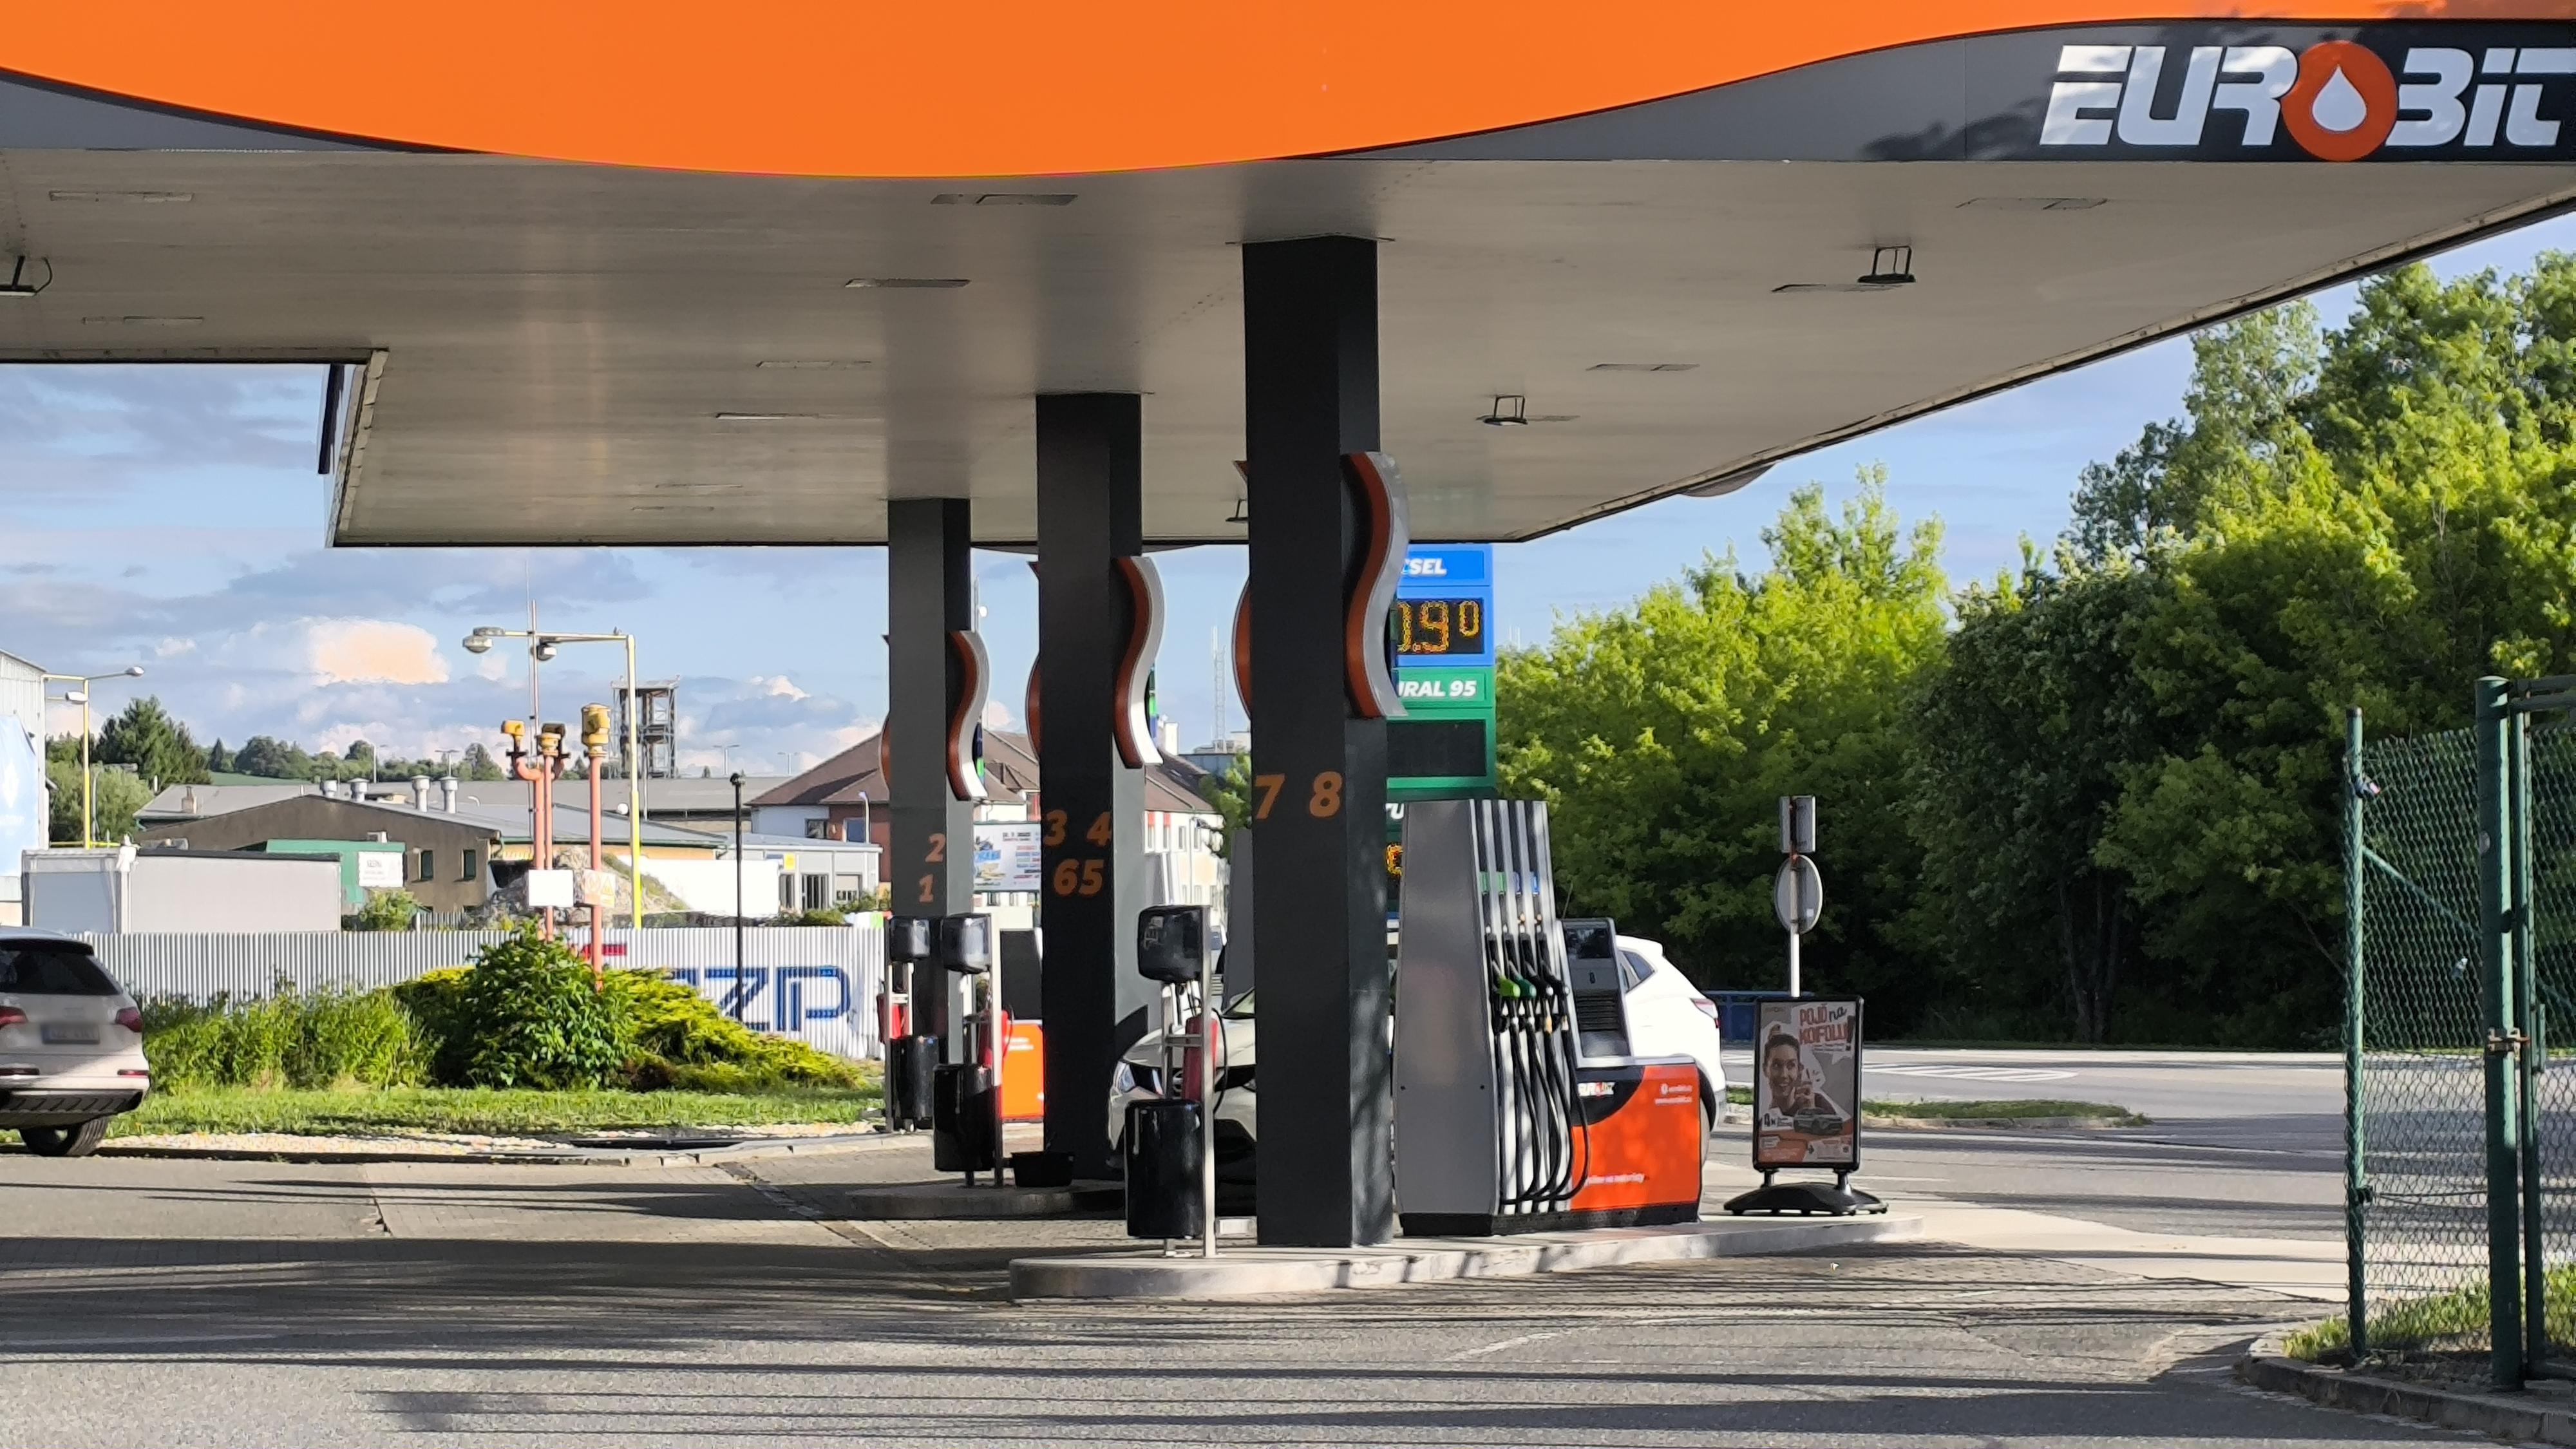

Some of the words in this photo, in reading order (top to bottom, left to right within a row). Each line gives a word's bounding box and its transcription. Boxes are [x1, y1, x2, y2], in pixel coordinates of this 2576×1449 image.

[1449, 679, 1477, 697] 95
[1254, 773, 1285, 820] 7
[1309, 771, 1343, 818] 8
[1043, 809, 1068, 846] 3
[1086, 811, 1112, 847] 4
[925, 833, 946, 863] 2
[919, 874, 934, 902] 1
[1829, 1006, 1847, 1022] na
